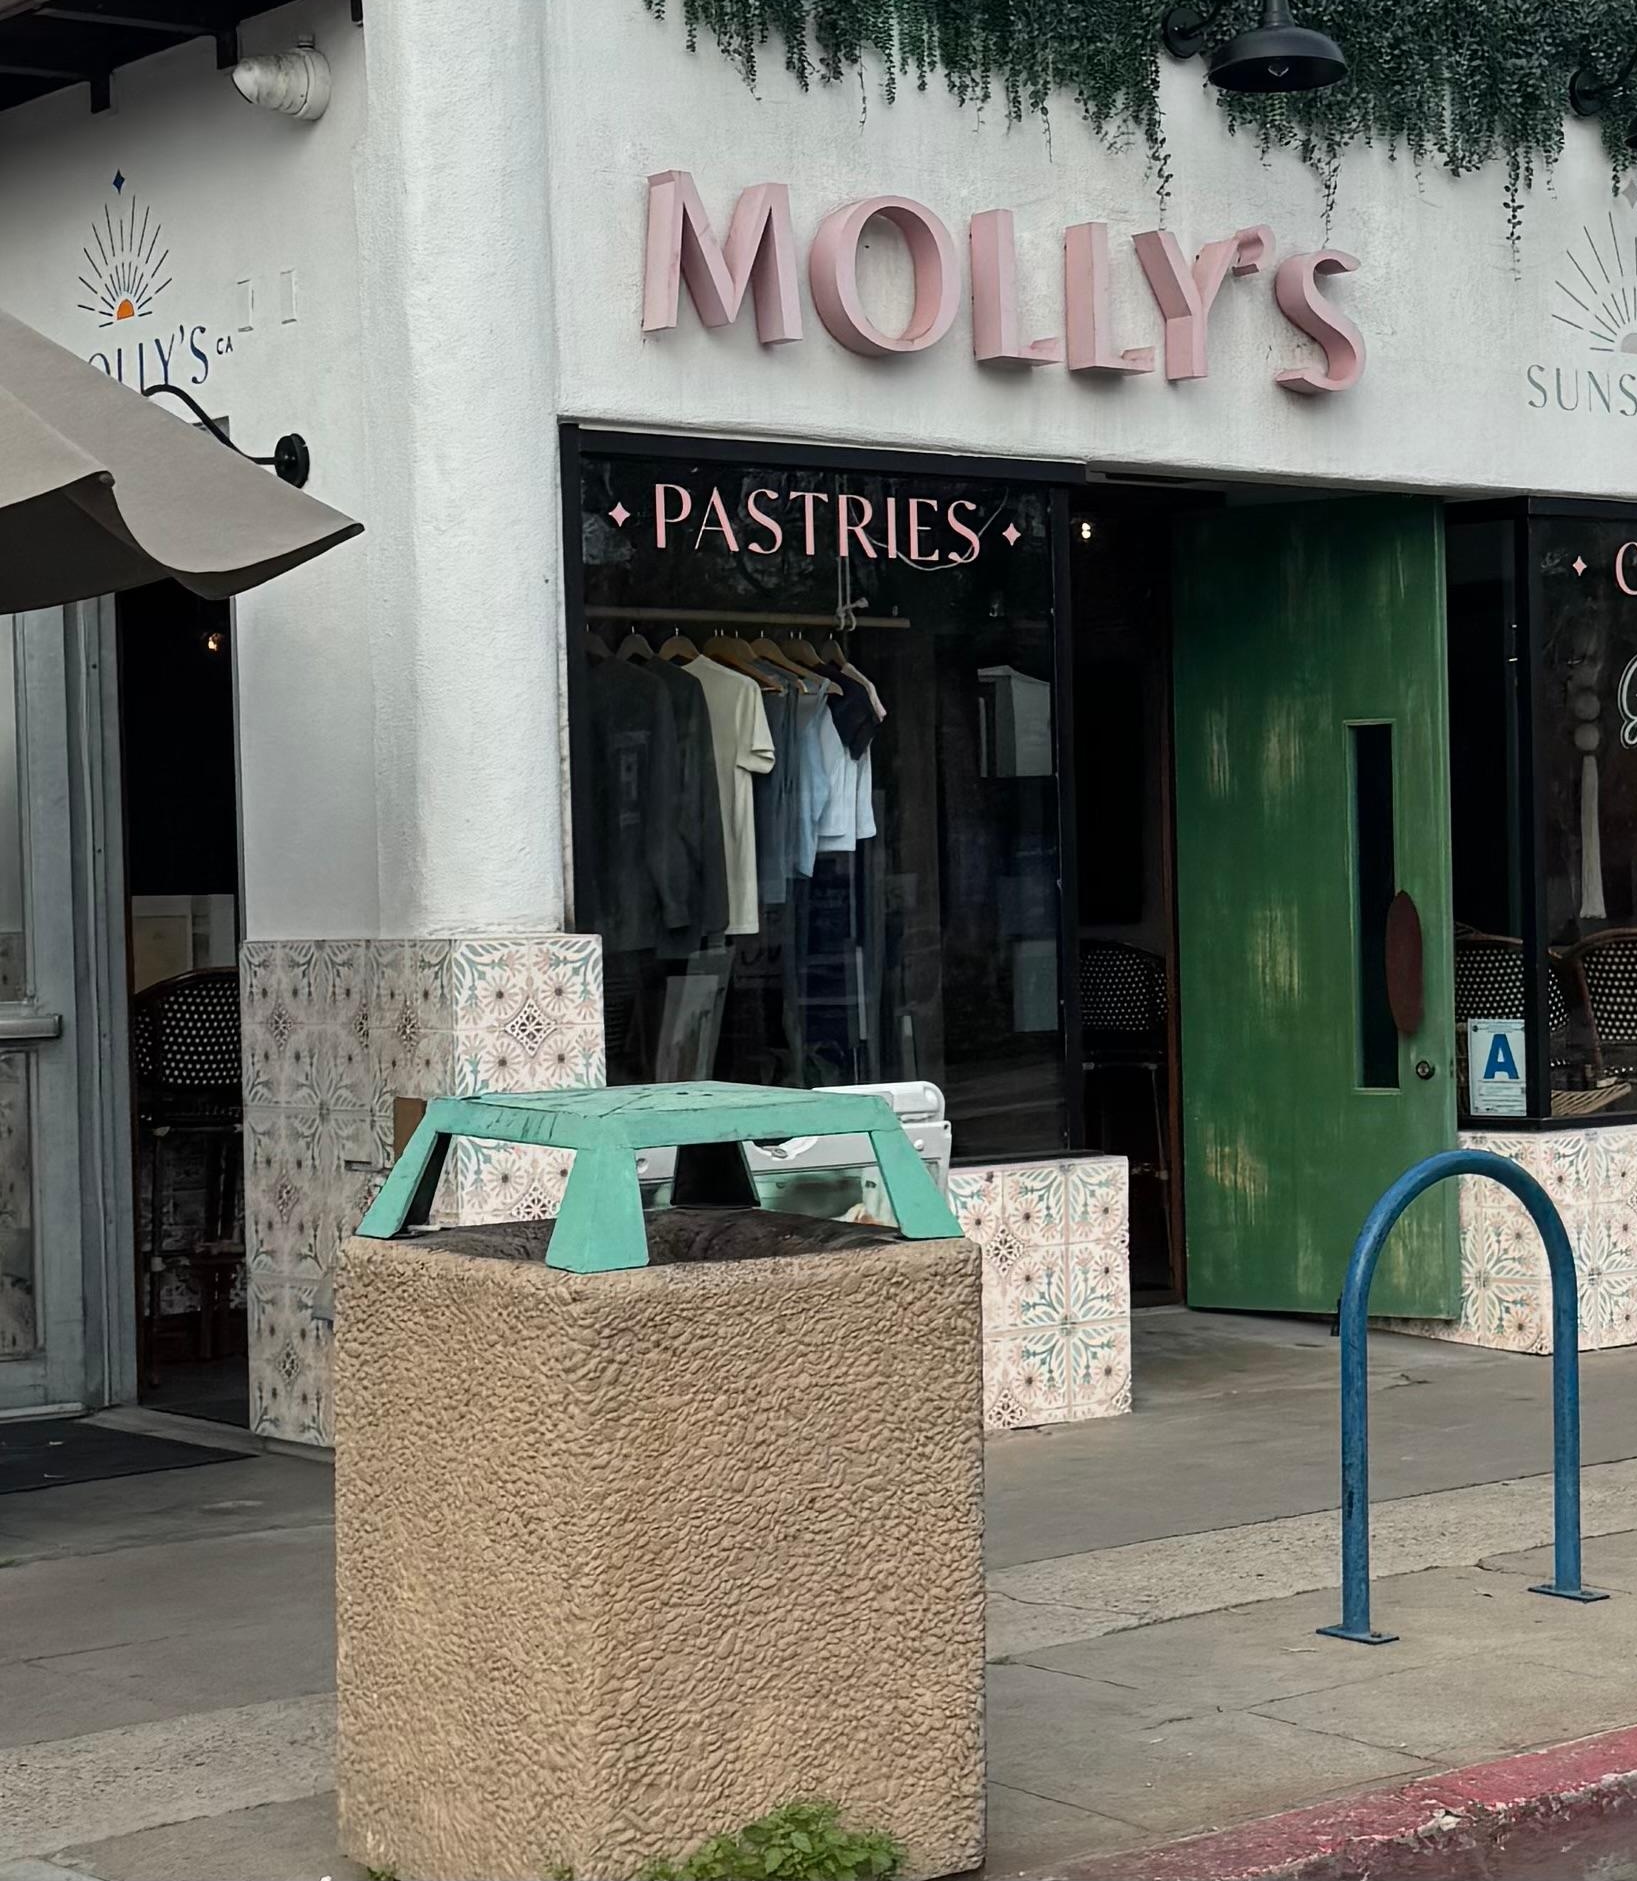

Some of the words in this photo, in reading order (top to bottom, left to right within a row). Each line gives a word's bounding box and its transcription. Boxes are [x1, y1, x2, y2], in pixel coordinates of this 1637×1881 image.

[642, 170, 1366, 395] MOLLY'S
[216, 335, 233, 355] CA
[654, 482, 982, 564] PASTRIES
[1483, 1034, 1520, 1080] A
